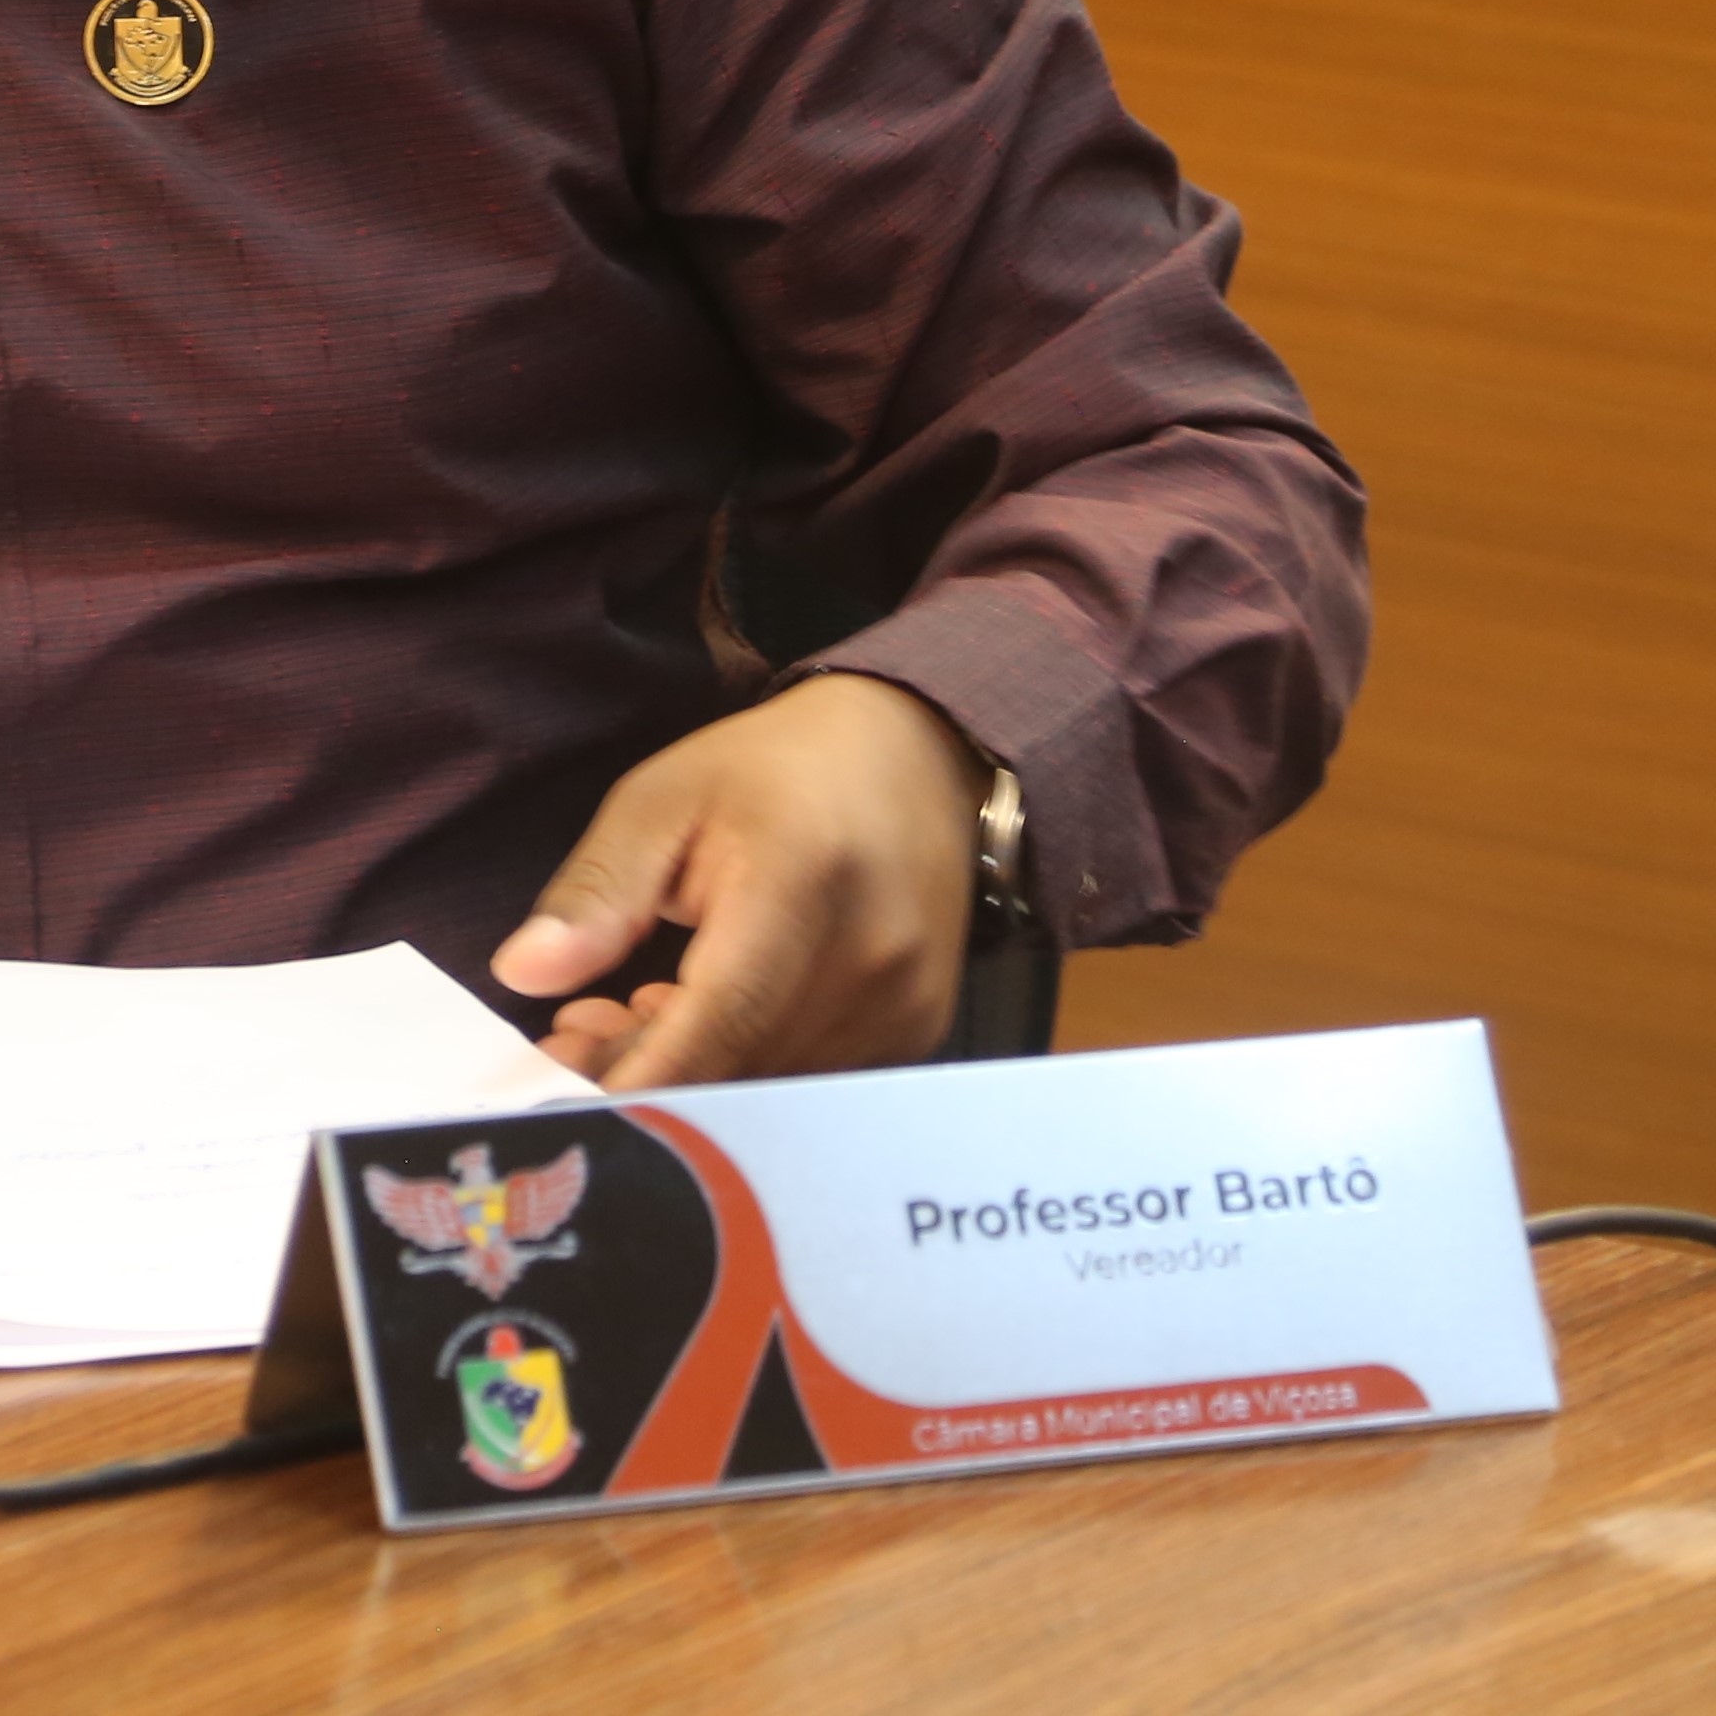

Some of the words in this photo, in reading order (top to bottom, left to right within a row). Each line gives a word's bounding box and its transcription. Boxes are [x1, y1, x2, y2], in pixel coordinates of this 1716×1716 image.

[905, 1185, 1192, 1247] Professor
[1214, 1156, 1379, 1215] Bartô
[1064, 1238, 1245, 1282] Vereador
[911, 1410, 1041, 1453] Câmara
[1044, 1394, 1203, 1435] Municipal
[1207, 1389, 1251, 1423] de
[1252, 1381, 1360, 1424] Viçosa
